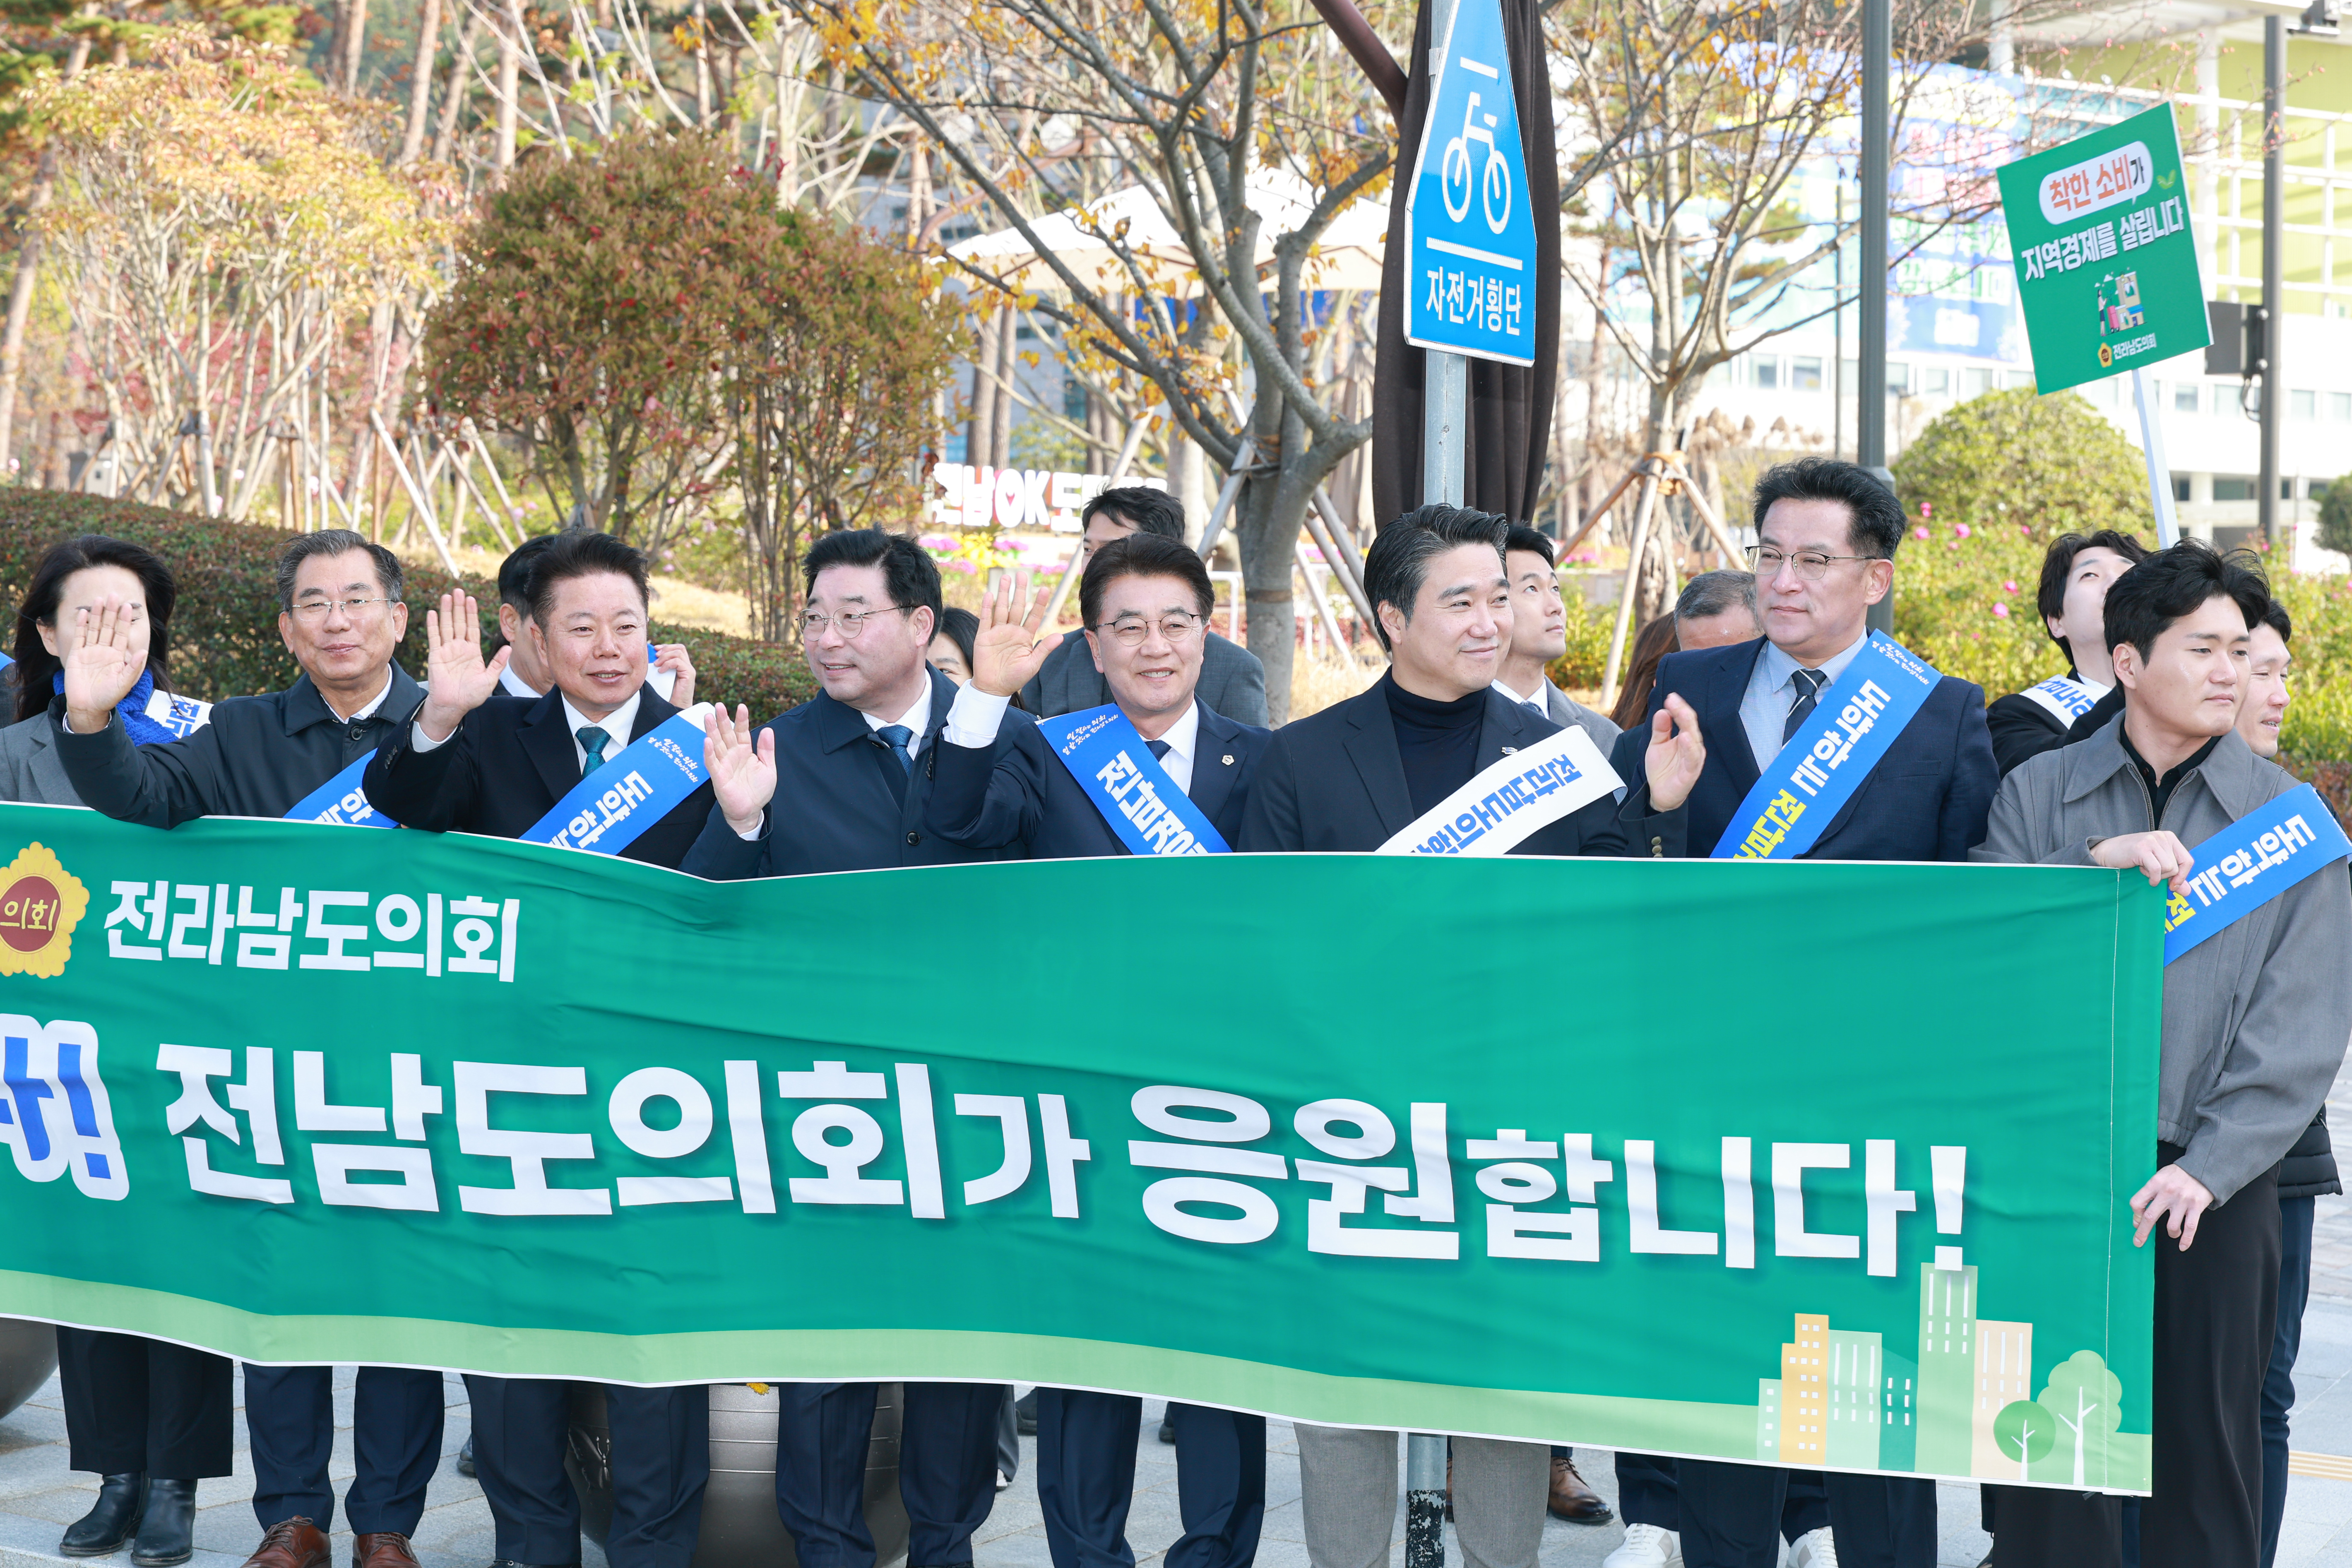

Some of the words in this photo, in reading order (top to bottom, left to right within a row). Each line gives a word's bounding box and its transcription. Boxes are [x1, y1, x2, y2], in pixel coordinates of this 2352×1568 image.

[2049, 169, 2091, 212] 착한
[2096, 154, 2145, 200] 소비가
[2020, 221, 2118, 282] 지역경제를
[2119, 195, 2184, 252] 살립니다
[1426, 266, 1521, 336] 자전거횡단
[2113, 332, 2157, 360] 전라남도의회
[932, 463, 1167, 532] 전남OK도
[1908, 661, 1924, 673] 의회
[664, 739, 673, 748] 일
[683, 757, 697, 770] 의회
[1063, 746, 1070, 755] 일
[1090, 714, 1118, 733] 전라남도의회
[1067, 731, 1078, 740] 일
[1092, 715, 1105, 725] 의회
[1790, 679, 1891, 796] 도약하는
[674, 758, 698, 782] 전라남도의회
[1096, 750, 1209, 854] 전남경
[2189, 814, 2316, 907] 도약하는
[0, 898, 58, 931] 의회
[104, 880, 519, 982] 전라남도의회
[156, 1043, 1091, 1219] 전남도의회가
[1128, 1085, 1967, 1277] 응원합니다!
